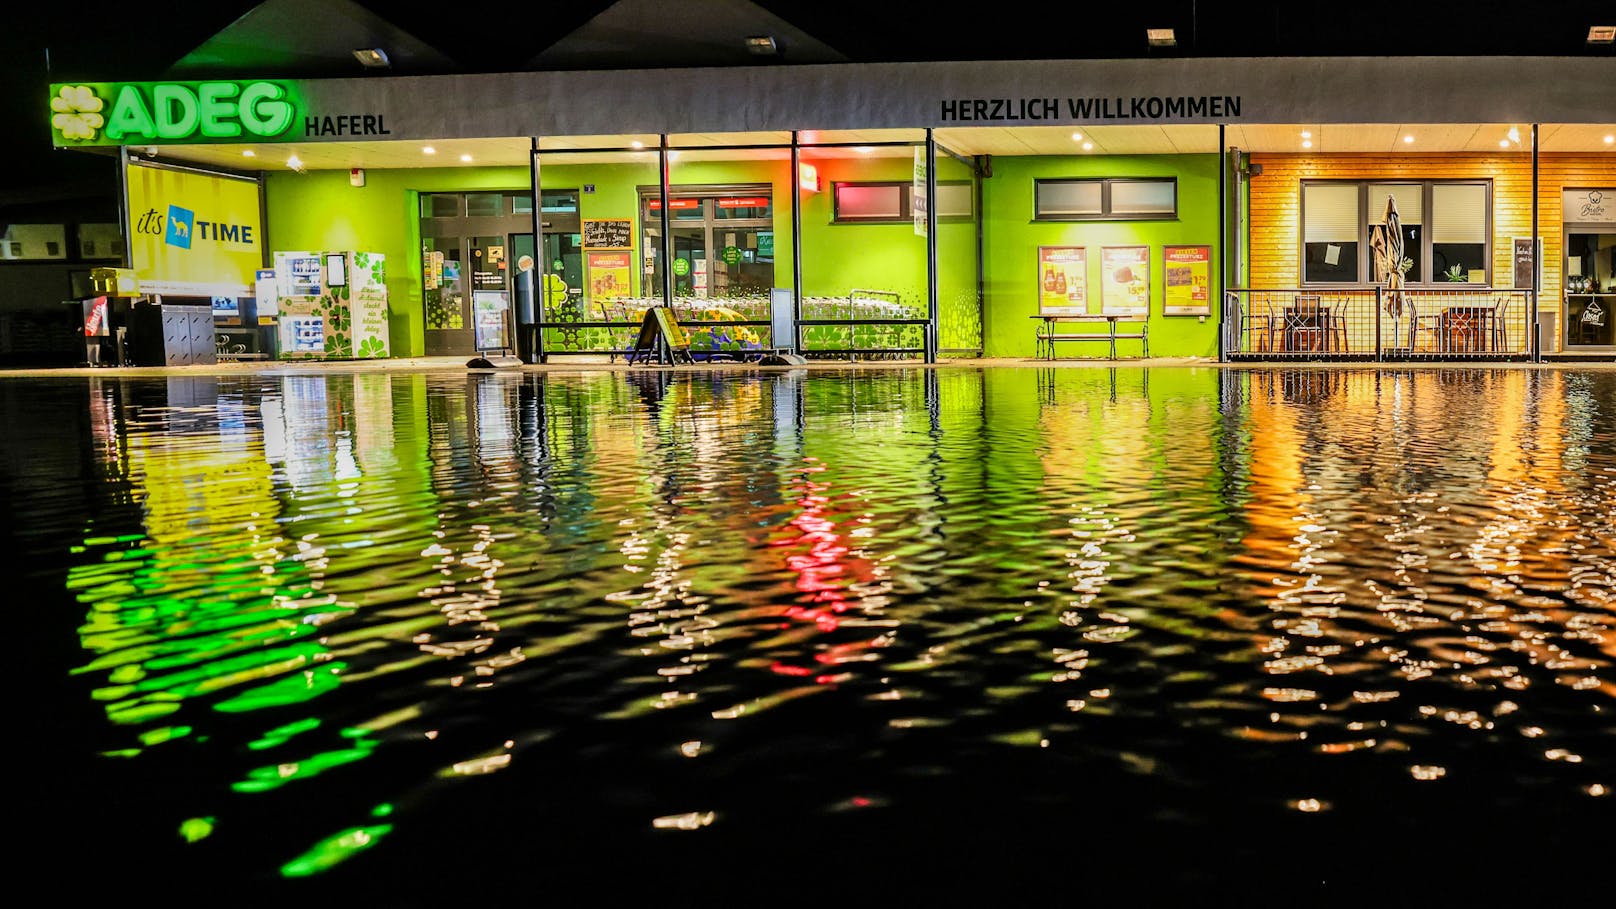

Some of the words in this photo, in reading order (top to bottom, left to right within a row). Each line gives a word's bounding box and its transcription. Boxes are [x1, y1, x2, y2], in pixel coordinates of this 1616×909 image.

[105, 82, 295, 140] ADEG
[941, 98, 1059, 121] HERZLICH
[1068, 96, 1242, 120] WILLKOMMEN
[305, 114, 391, 137] HAFERL
[1581, 203, 1605, 216] Bistro
[137, 208, 163, 235] it's
[196, 221, 253, 244] TIME
